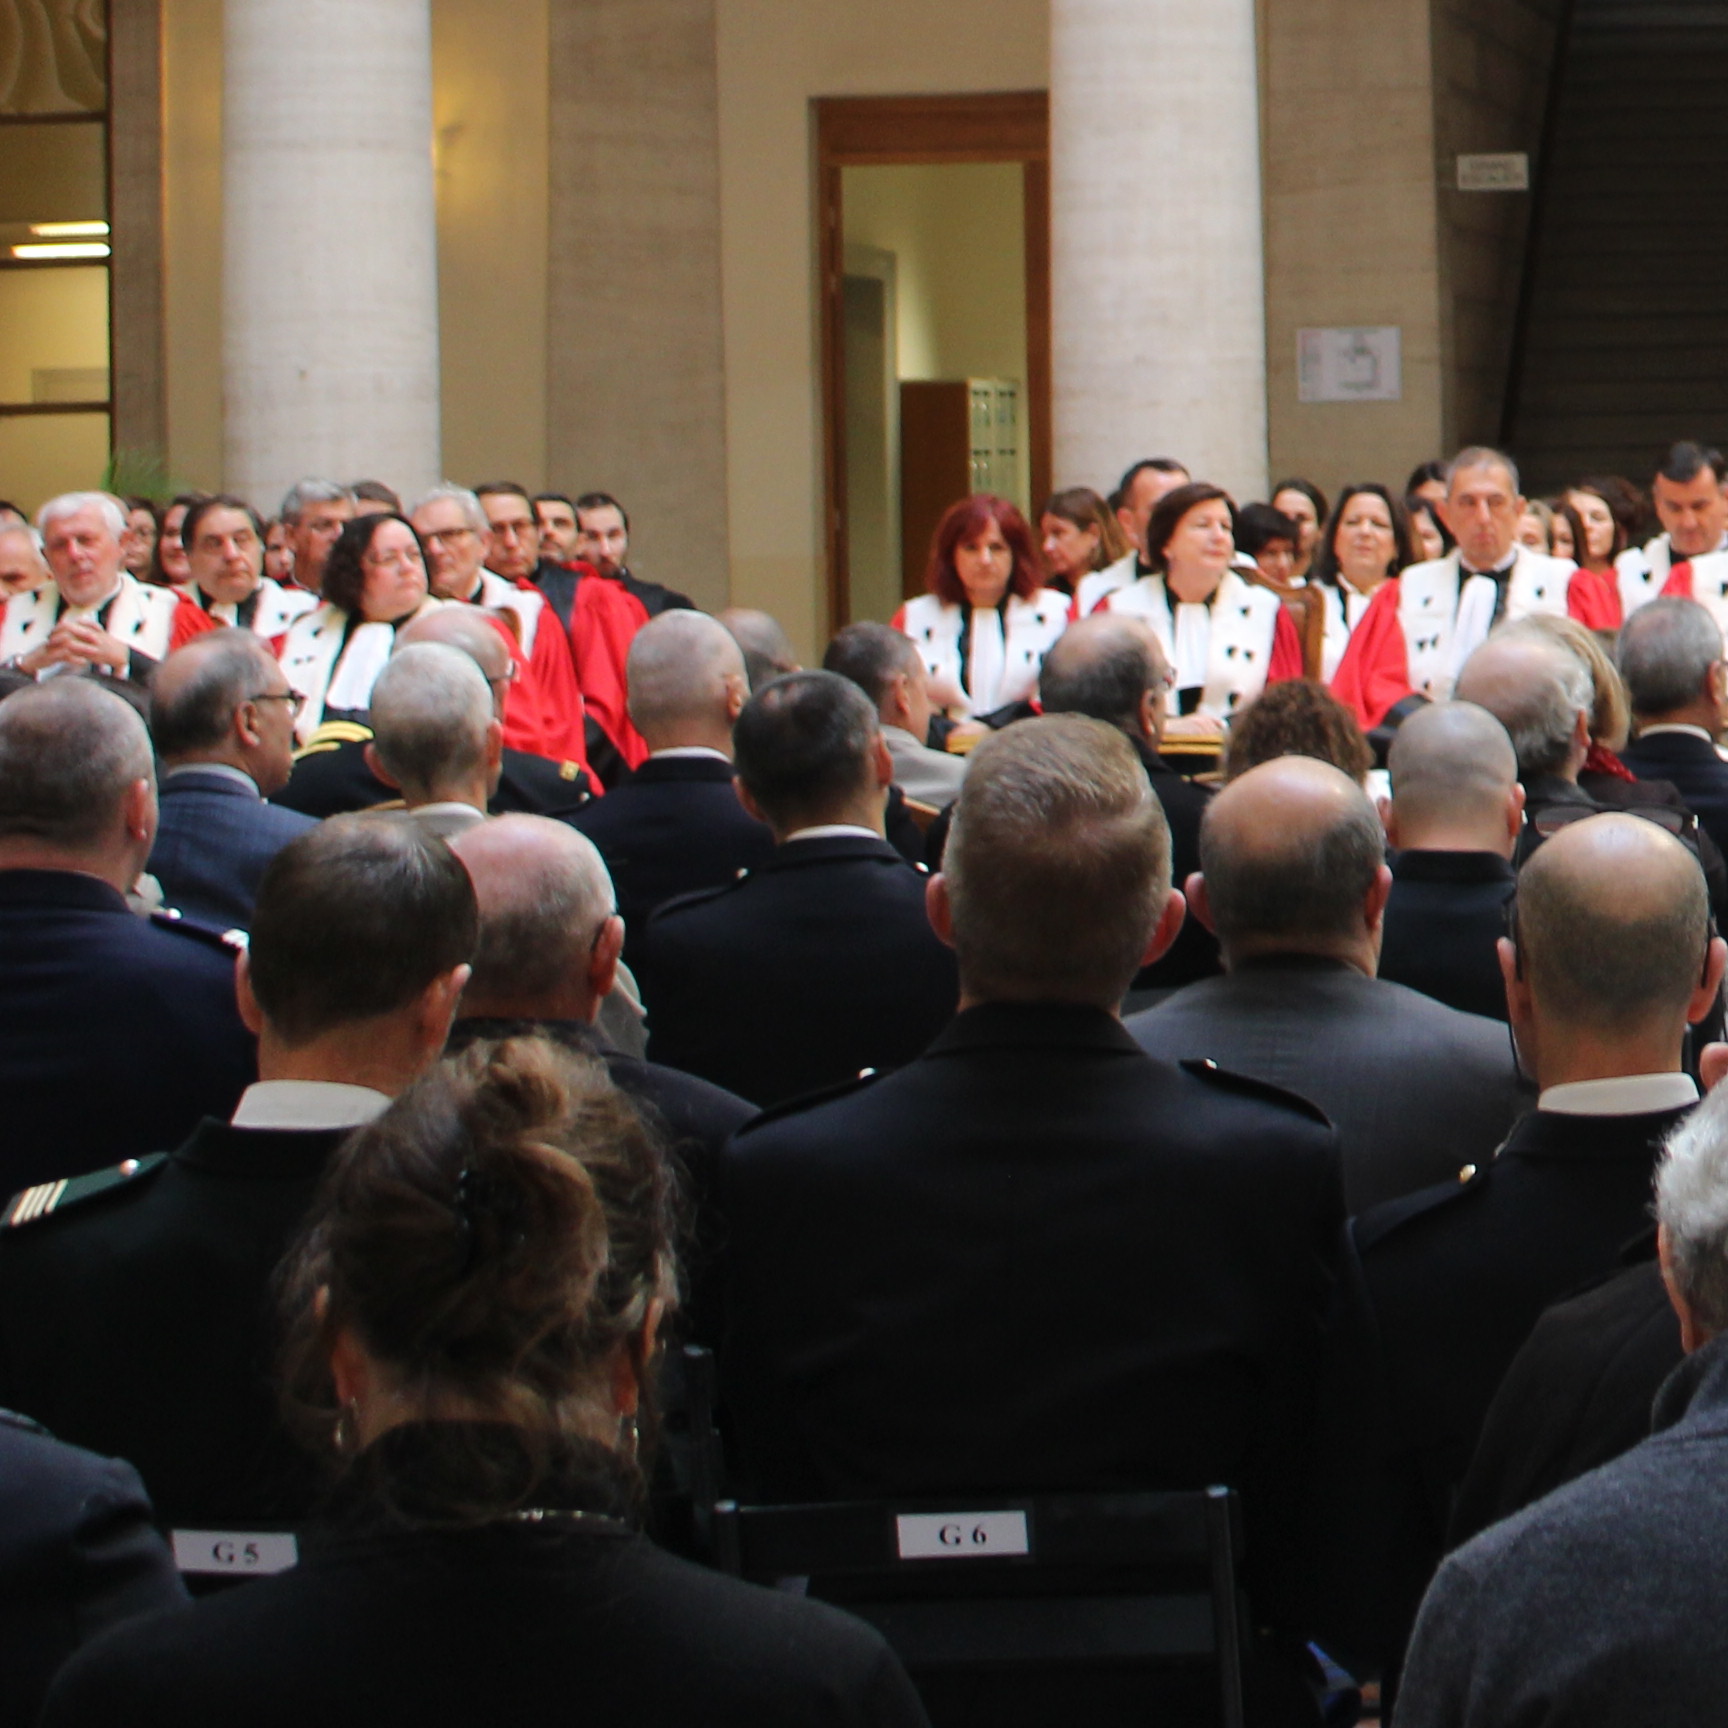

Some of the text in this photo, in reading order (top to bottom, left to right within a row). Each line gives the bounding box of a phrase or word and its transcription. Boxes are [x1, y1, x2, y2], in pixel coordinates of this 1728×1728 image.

[939, 1523, 987, 1546] G 6
[212, 1541, 260, 1564] G 5
